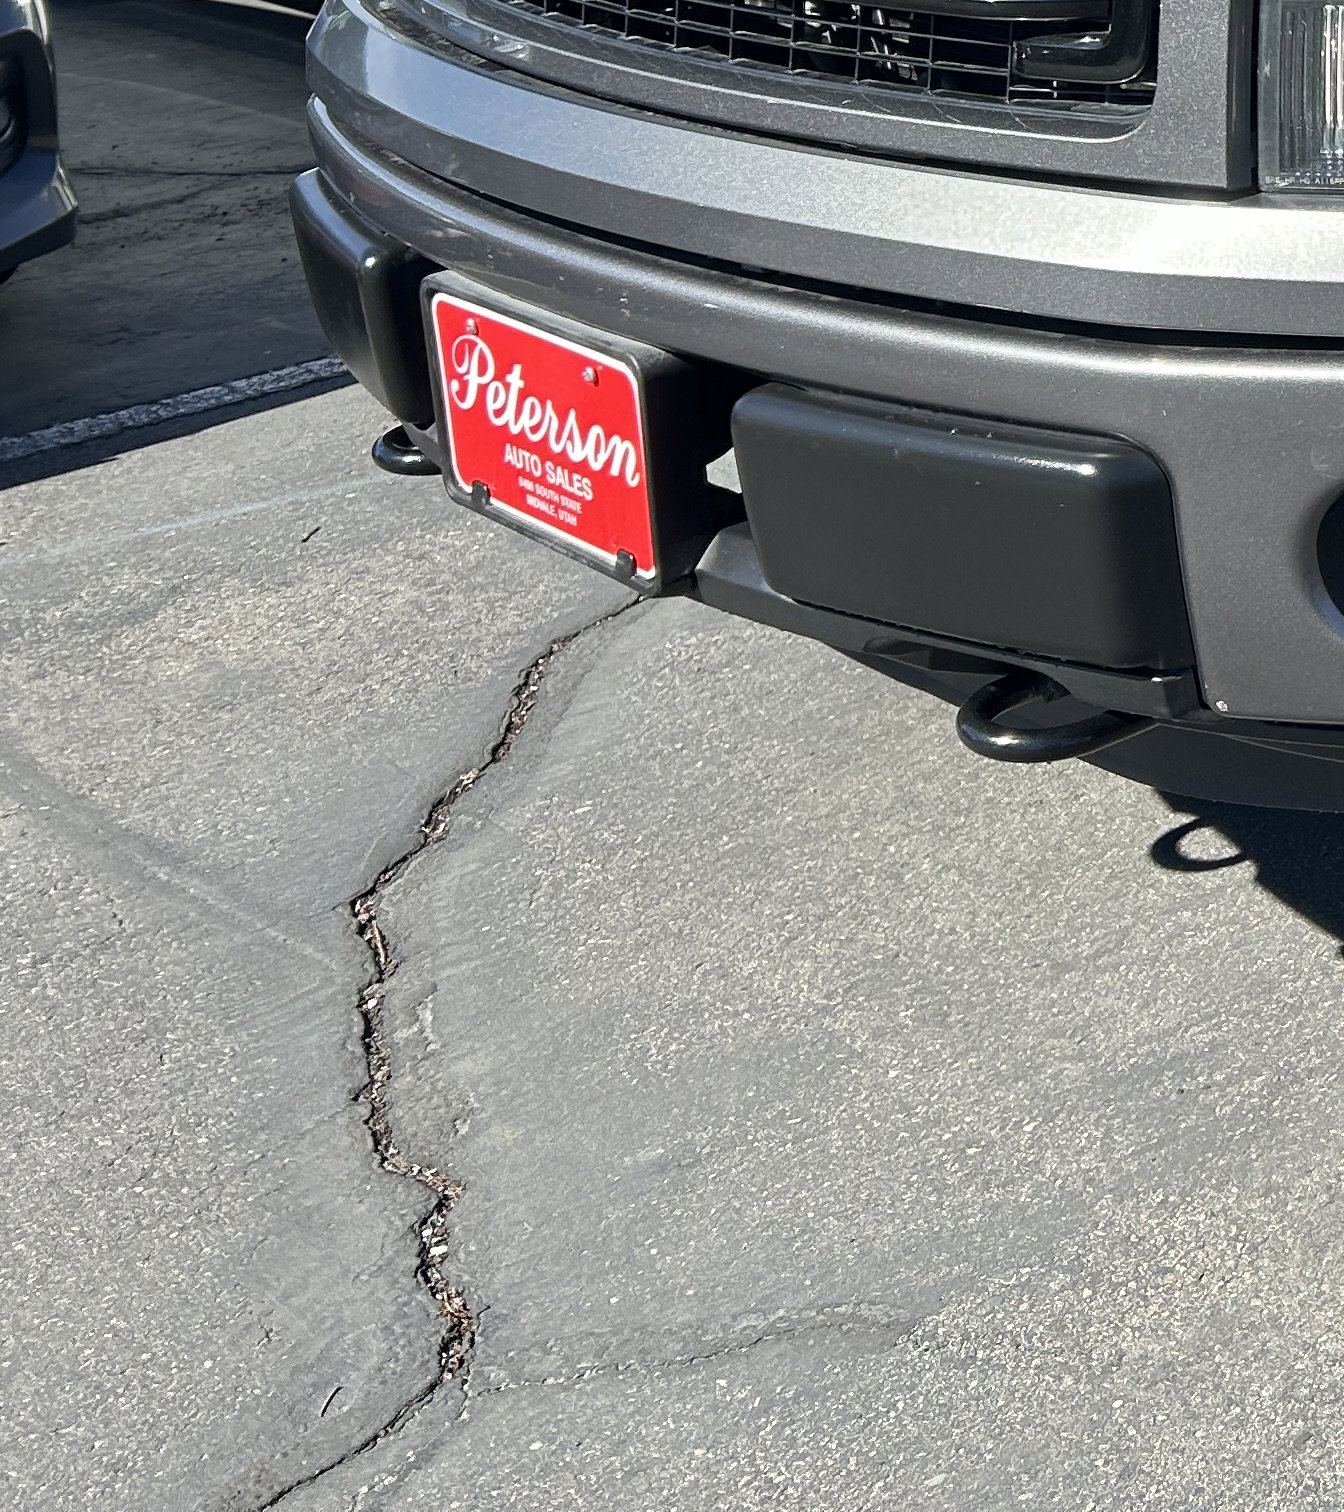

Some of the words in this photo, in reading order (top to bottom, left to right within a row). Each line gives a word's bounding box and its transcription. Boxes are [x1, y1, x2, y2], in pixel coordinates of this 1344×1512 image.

[451, 334, 640, 487] Peterson
[504, 443, 542, 478] AUTO
[545, 461, 594, 502] SALES
[535, 483, 559, 504] SOUTH
[560, 494, 582, 515] STATE
[558, 508, 577, 527] UTAH
